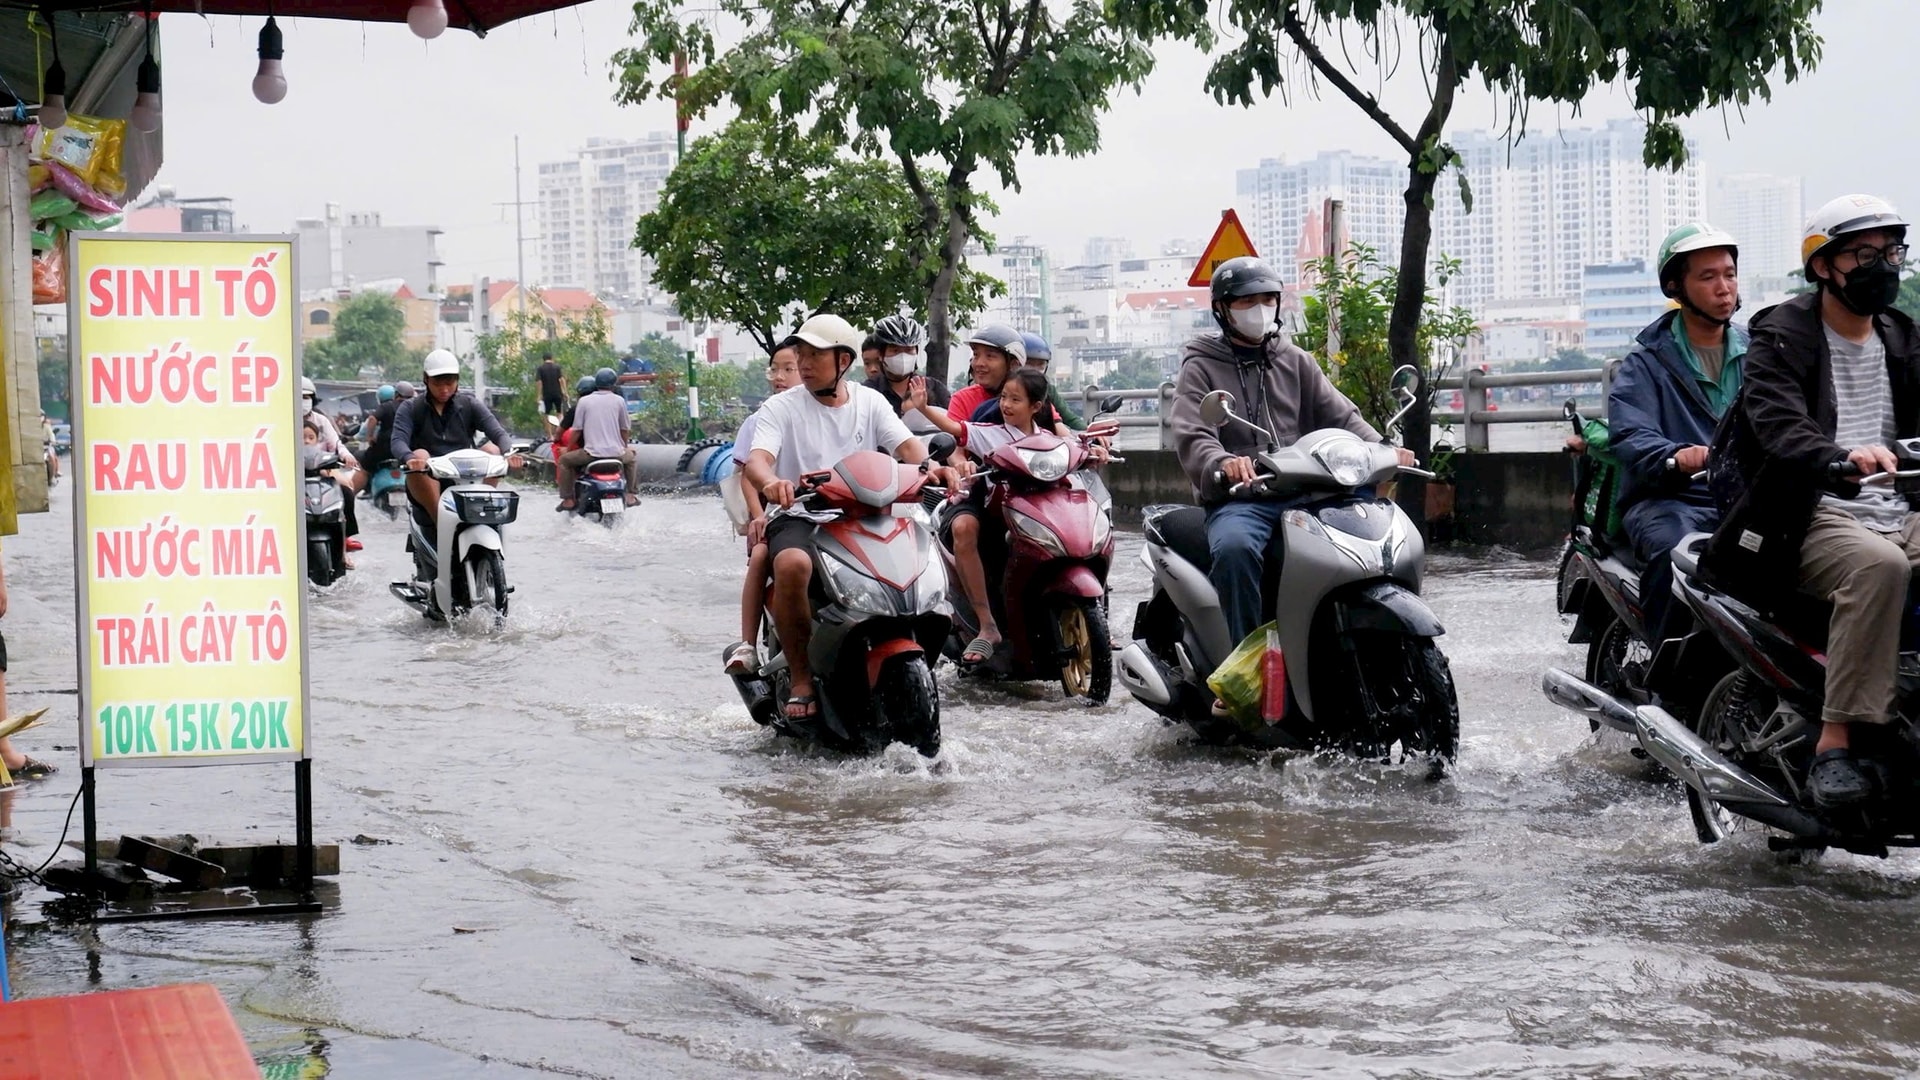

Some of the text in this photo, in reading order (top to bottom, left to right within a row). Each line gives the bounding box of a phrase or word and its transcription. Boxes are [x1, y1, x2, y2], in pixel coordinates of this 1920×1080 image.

[89, 252, 278, 318] SINH TỐ
[91, 342, 279, 404] NƯỚC ÉP
[94, 428, 277, 491] RAU MÁ
[96, 514, 281, 578] NƯỚC MÍA
[97, 600, 287, 665] TRÁI CÂY TÔ
[100, 701, 289, 755] 10K 15K 20K
